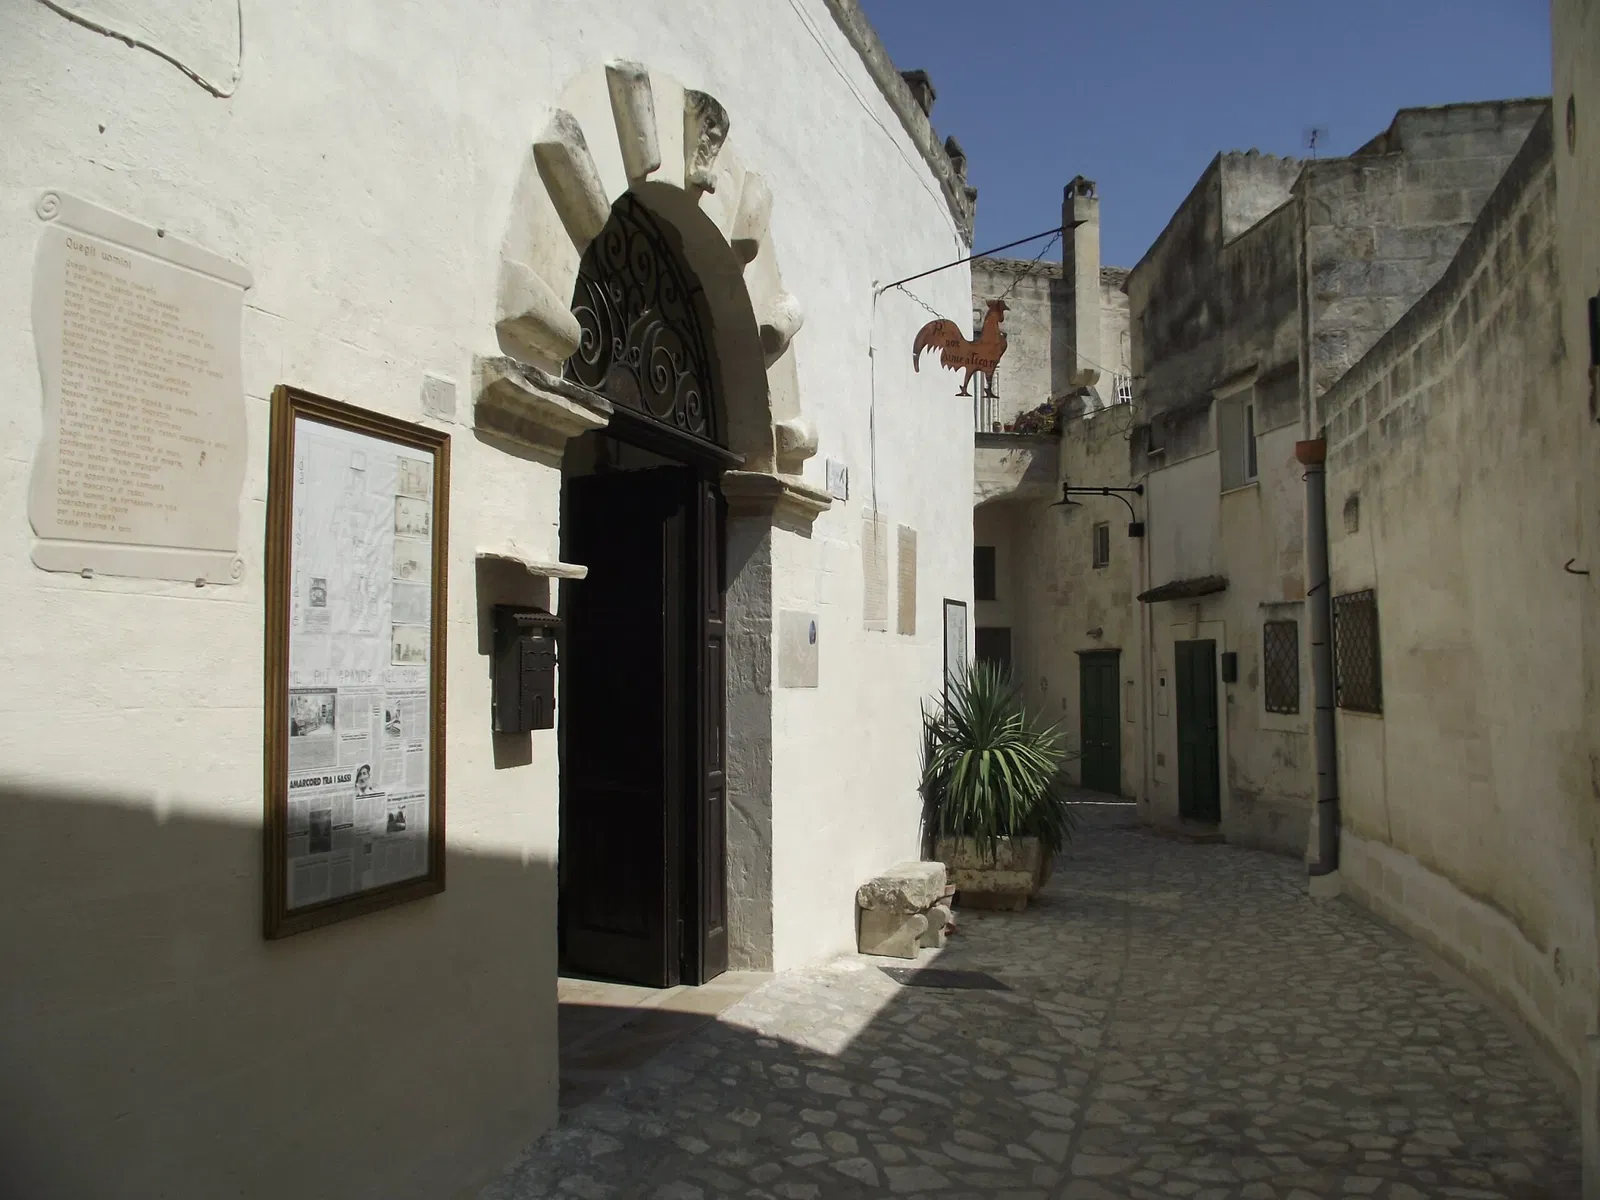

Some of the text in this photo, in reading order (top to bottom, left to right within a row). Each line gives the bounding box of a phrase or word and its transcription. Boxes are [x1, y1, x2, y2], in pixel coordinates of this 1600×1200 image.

[65, 237, 132, 270] Quegli uomini
[289, 776, 322, 789] AMARCORD
[322, 775, 333, 786] TRA
[336, 773, 352, 784] SASSI
